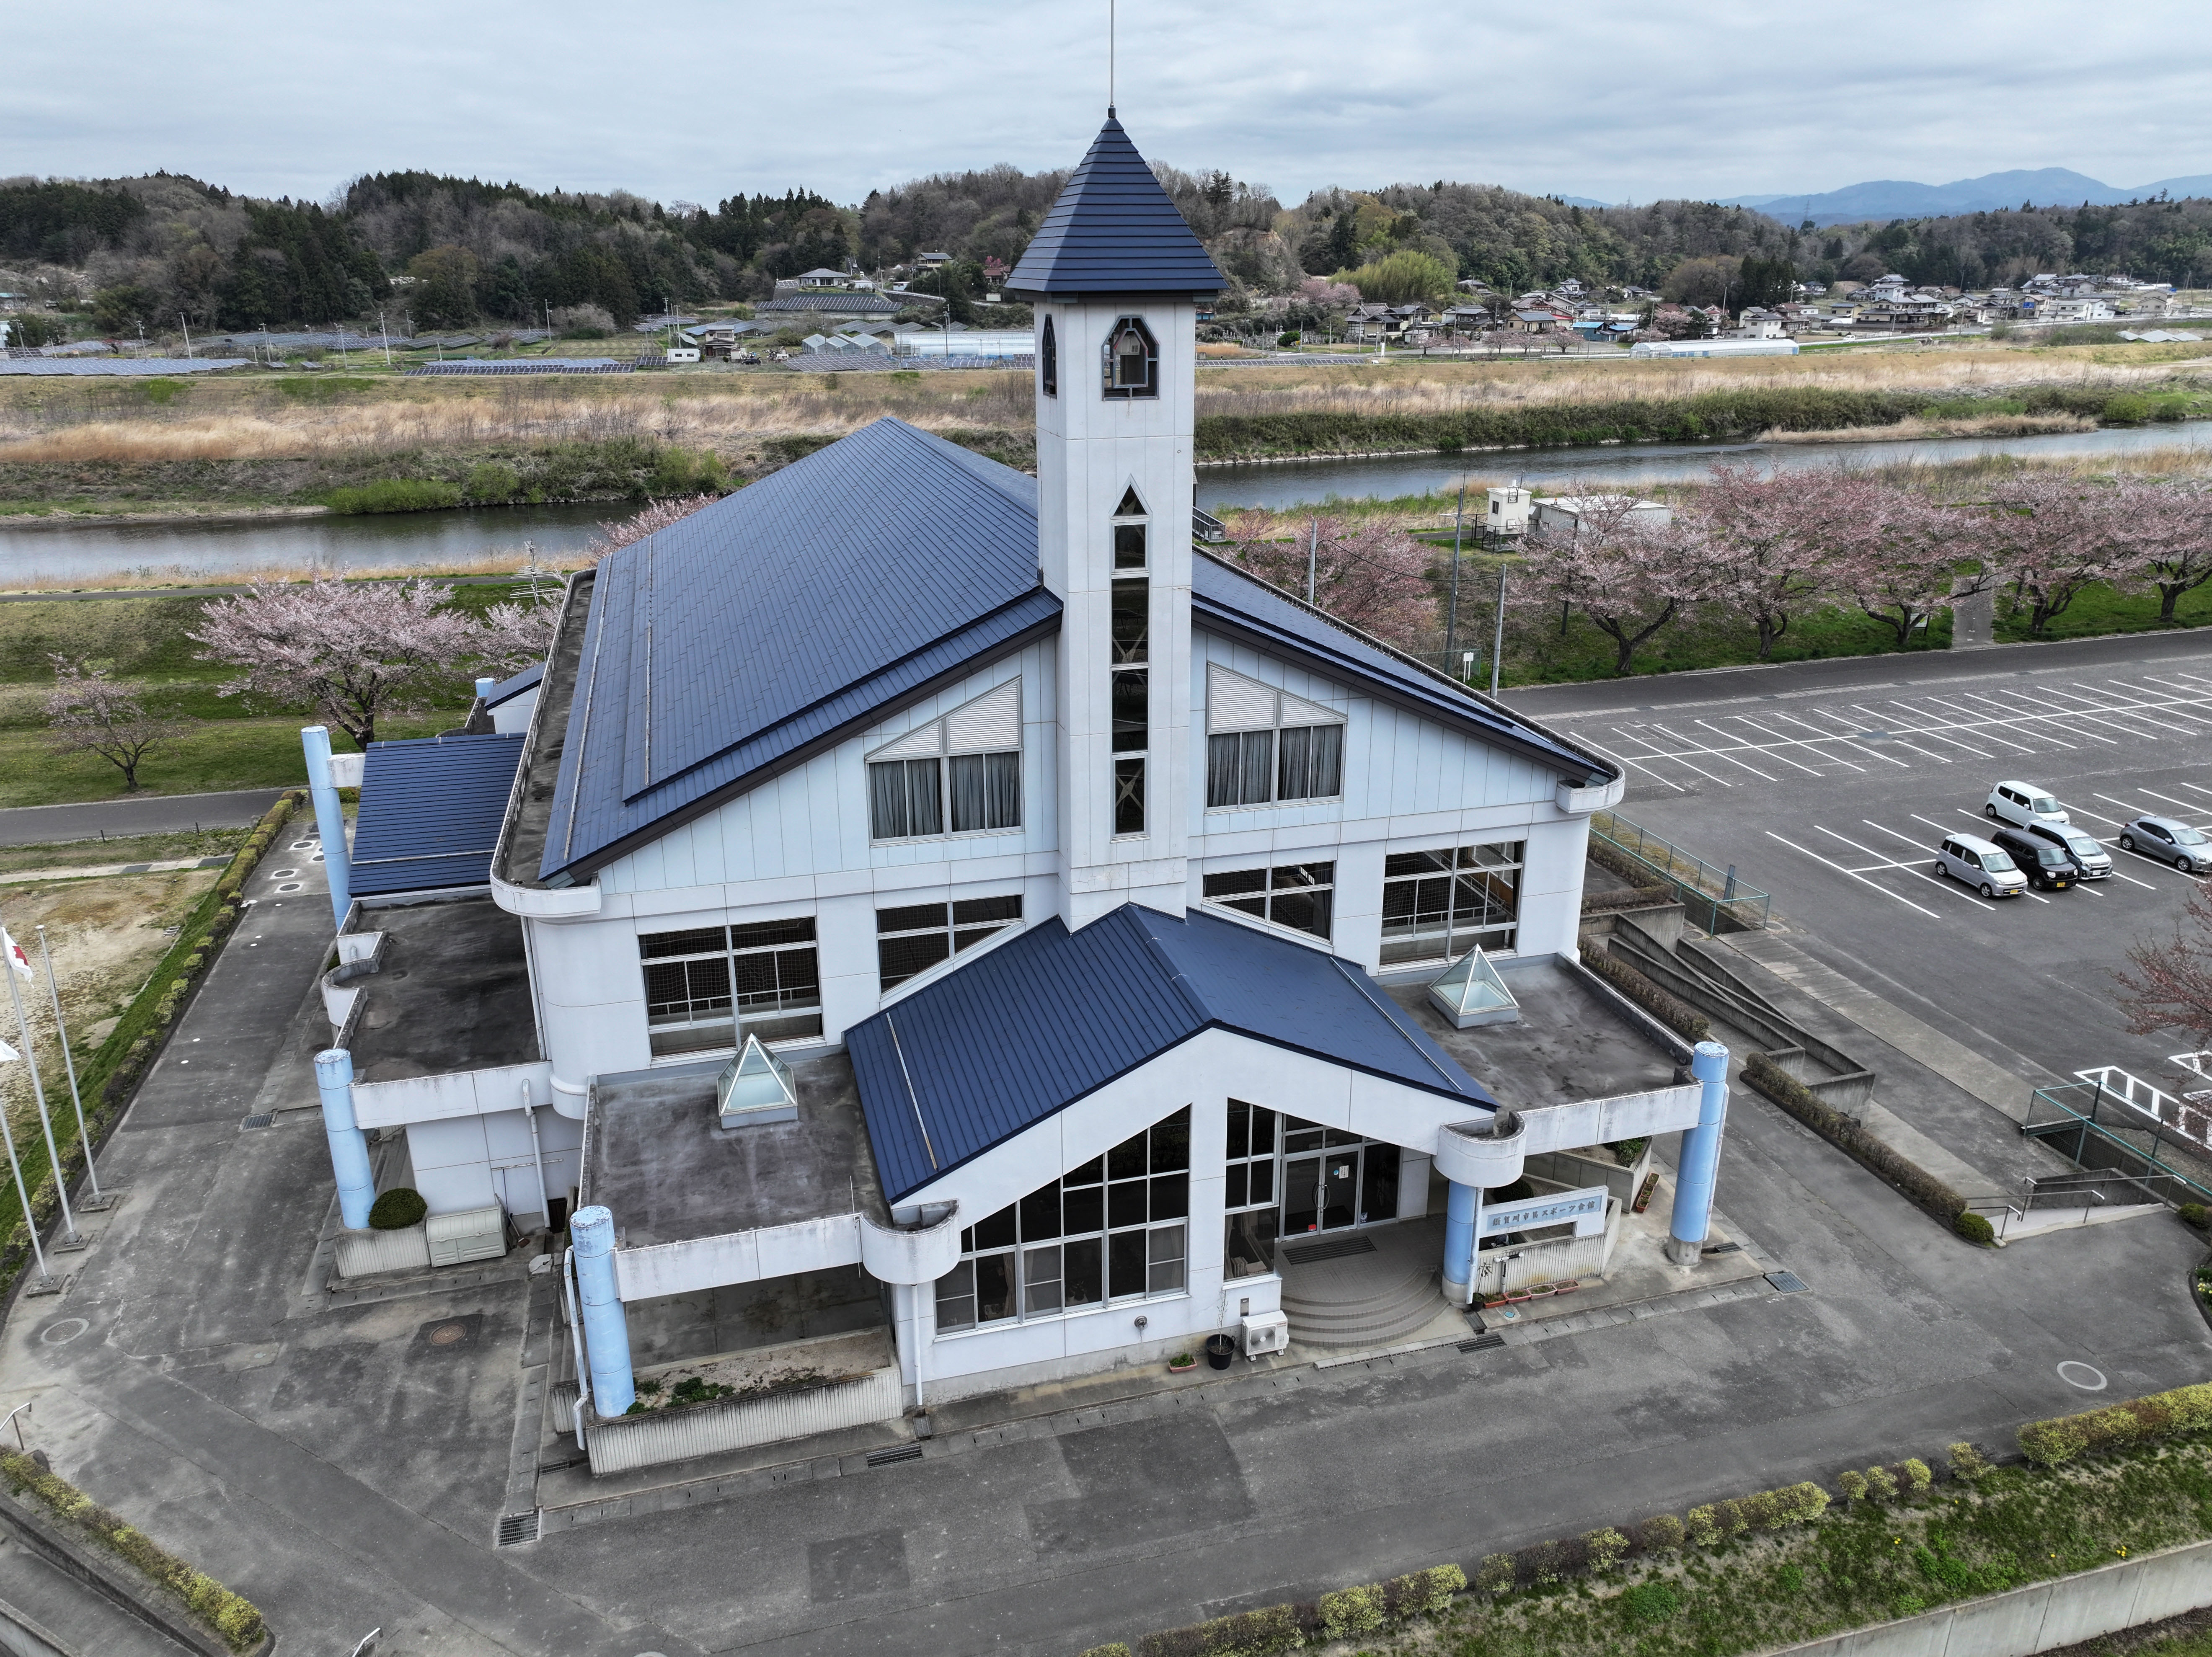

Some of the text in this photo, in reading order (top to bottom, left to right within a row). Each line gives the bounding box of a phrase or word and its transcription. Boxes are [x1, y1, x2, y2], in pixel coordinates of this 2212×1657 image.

[1492, 1200, 1595, 1226] 須賀川市民スポーツ会館
